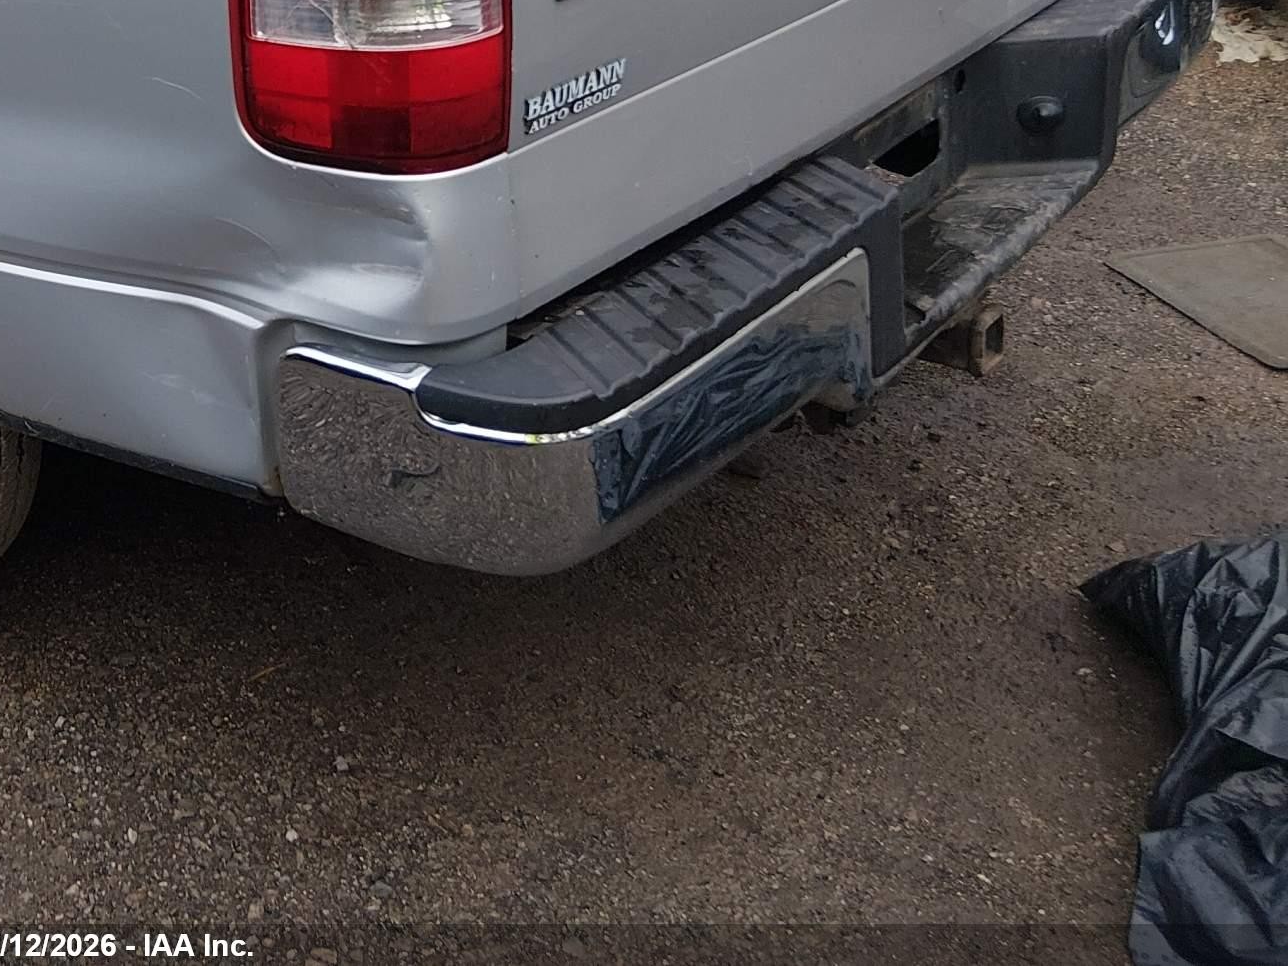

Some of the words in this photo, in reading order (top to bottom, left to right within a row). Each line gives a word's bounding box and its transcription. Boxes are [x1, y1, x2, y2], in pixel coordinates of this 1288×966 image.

[526, 58, 626, 121] BAUMANN
[528, 107, 570, 134] AUTO
[573, 83, 622, 113] GROUP
